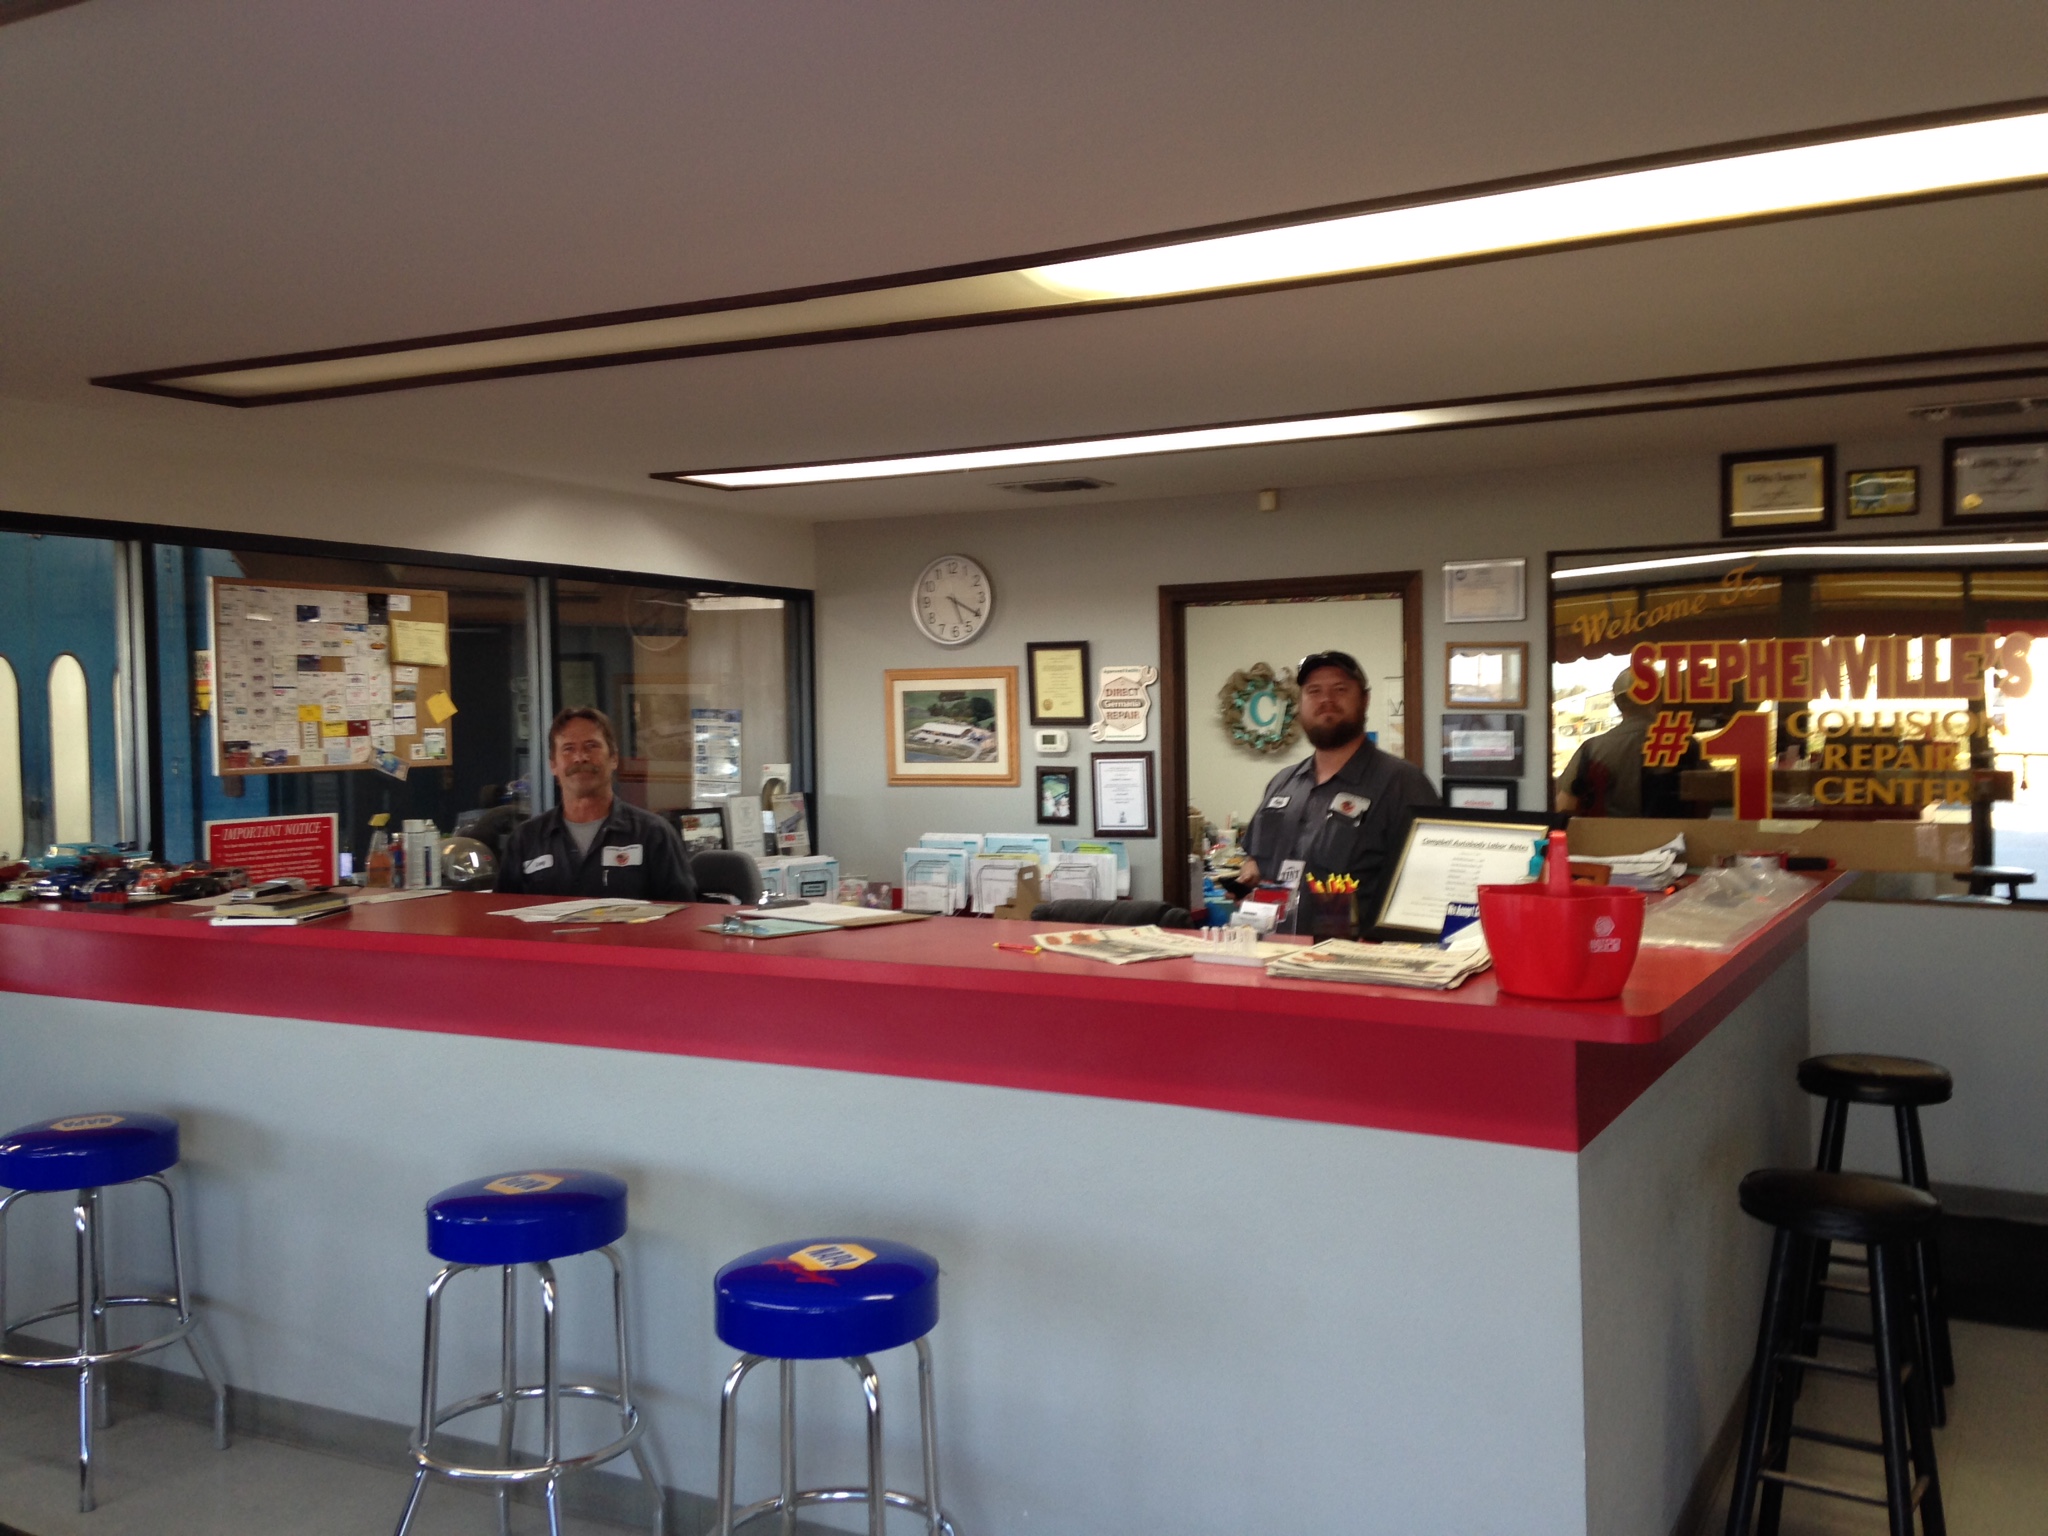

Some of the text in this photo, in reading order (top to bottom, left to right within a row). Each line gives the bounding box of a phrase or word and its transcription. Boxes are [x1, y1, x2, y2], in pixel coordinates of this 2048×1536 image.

[935, 569, 942, 580] 11
[947, 562, 958, 574] 12
[926, 580, 936, 592] 10
[973, 575, 981, 587] 2
[924, 596, 931, 608] 9
[978, 591, 986, 604] 3
[1570, 593, 1707, 647] Welcome
[1720, 563, 1762, 607] To
[928, 612, 936, 625] 8
[938, 624, 946, 635] 7
[952, 625, 960, 638] 6
[965, 620, 973, 633] 5
[1627, 631, 2034, 706] STEPHENVILLE'S
[1105, 688, 1140, 697] DIRECT
[1104, 699, 1142, 708] Germania
[1249, 691, 1277, 727] C
[1106, 711, 1140, 720] REPAIR
[1785, 710, 2008, 739] COLLISION
[1822, 743, 1960, 771] REPAIR
[1812, 777, 1972, 806] CENTER
[222, 821, 322, 841] IMPORTANT NOTICE
[1486, 841, 1507, 850] Labor
[1508, 843, 1530, 852] Rates
[805, 1246, 860, 1268] NAPA
